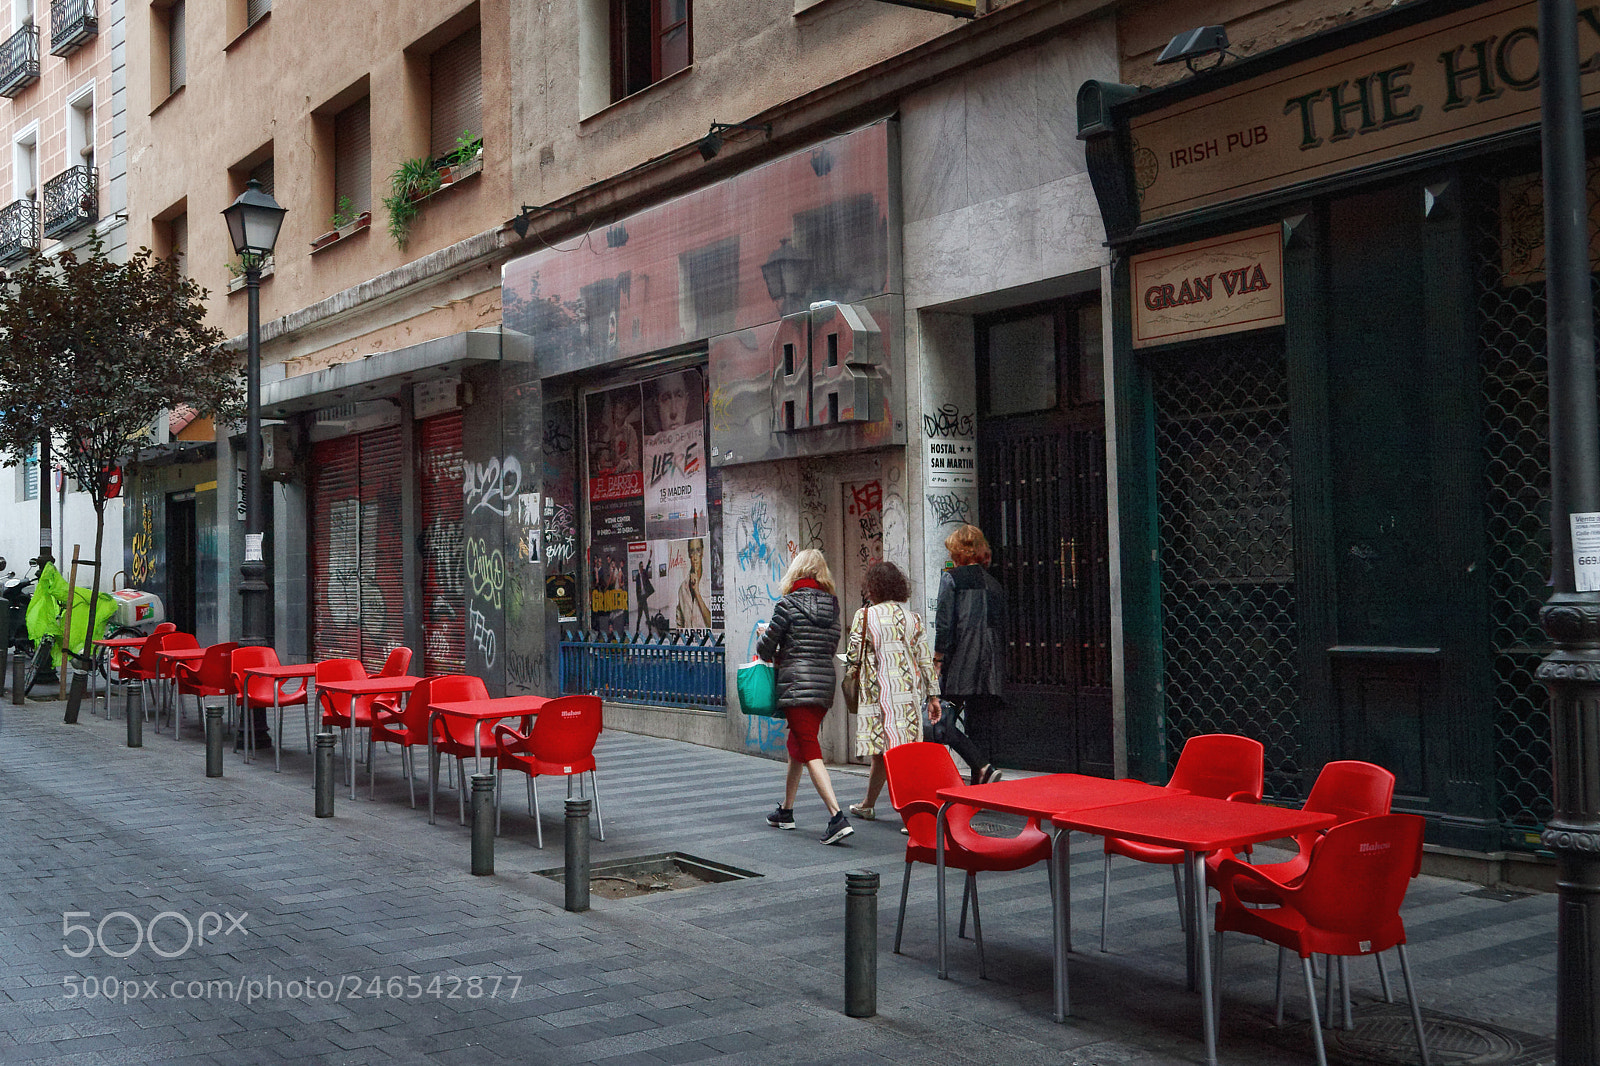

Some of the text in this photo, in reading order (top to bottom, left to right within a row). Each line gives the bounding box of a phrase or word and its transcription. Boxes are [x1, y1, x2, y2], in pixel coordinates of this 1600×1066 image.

[1283, 62, 1424, 151] THE
[1168, 124, 1269, 169] IRISH PUB
[1144, 263, 1271, 312] GRAN VIA
[650, 442, 700, 487] LIBRE
[930, 443, 957, 455] HOSTAL
[930, 457, 974, 469] SAN MARTIN
[660, 484, 692, 498] 15 MADRID
